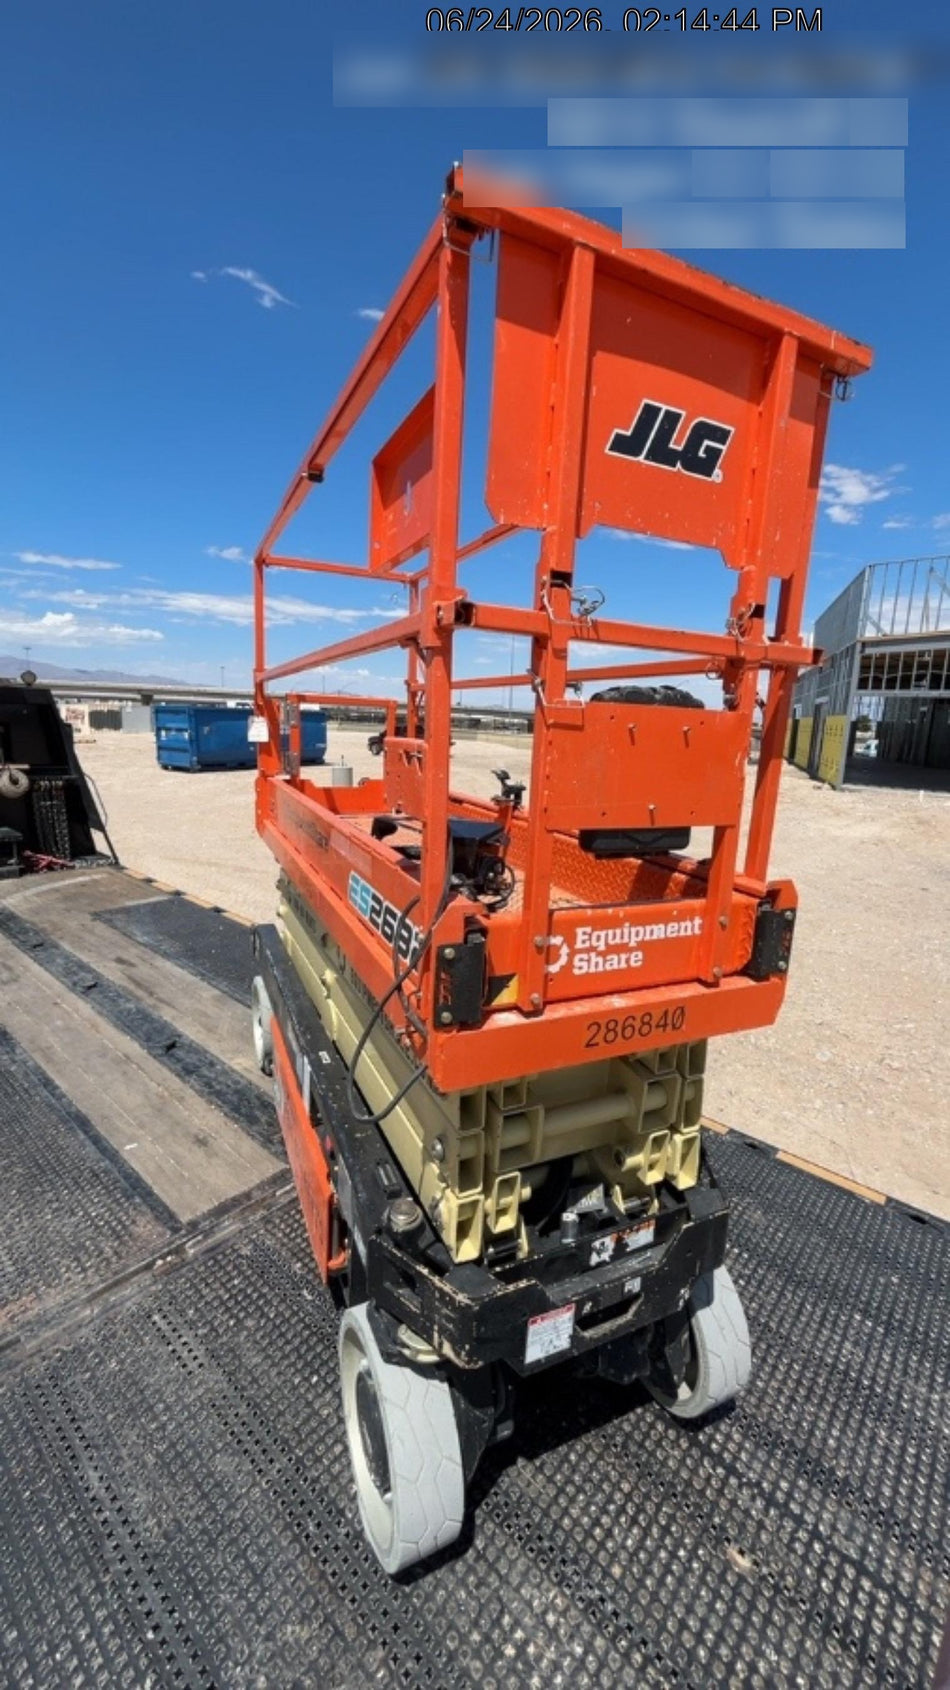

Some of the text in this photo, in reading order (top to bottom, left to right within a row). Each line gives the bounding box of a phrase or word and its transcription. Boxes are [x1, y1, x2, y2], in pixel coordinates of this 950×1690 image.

[605, 399, 735, 480] JLG
[575, 915, 703, 951] Equipment
[572, 950, 644, 976] Share
[583, 1006, 687, 1049] 286840
